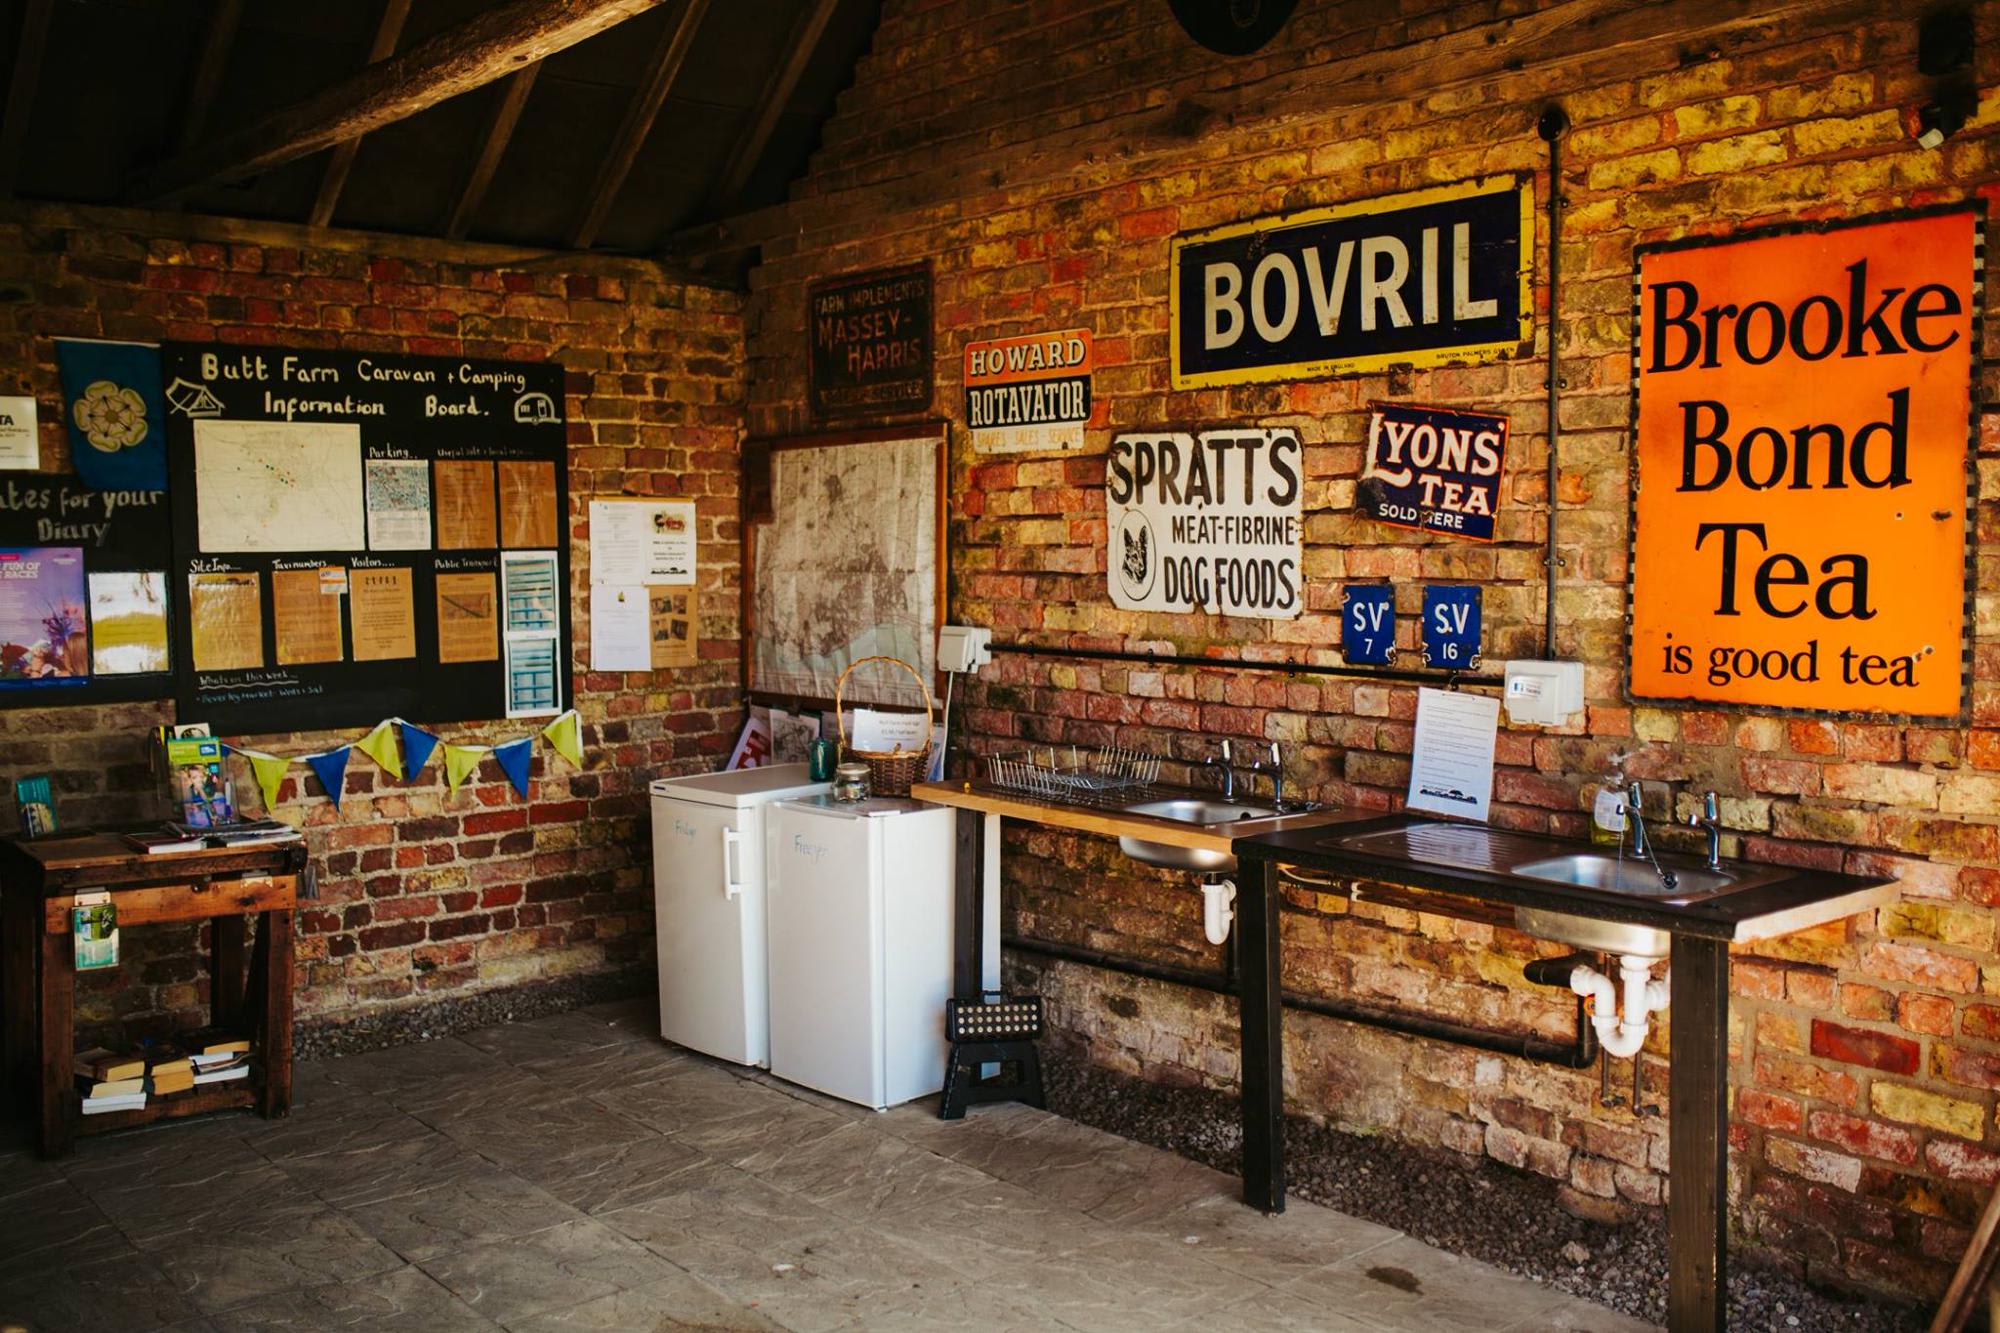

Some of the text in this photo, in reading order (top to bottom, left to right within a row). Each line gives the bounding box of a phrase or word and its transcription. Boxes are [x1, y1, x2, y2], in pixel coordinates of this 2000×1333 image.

[815, 279, 926, 315] FARM IMPLEMENTS
[1204, 222, 1498, 350] BOVRIL
[1646, 257, 1962, 375] Brooke
[847, 337, 922, 373] HARRIS
[970, 338, 1086, 376] HOWARD
[1462, 348, 1492, 358] PALMERS
[201, 353, 269, 381] Butt
[283, 356, 339, 383] Farm
[357, 359, 436, 383] Caravan
[459, 363, 526, 394] Camping
[264, 391, 490, 422] Information Board.
[970, 380, 1086, 426] ROTAVATOR
[1676, 386, 1913, 493] Bond
[60, 487, 96, 517] for
[101, 490, 165, 518] your
[1418, 472, 1491, 517] TEA
[1172, 515, 1296, 546] MEAT-FIBRINE
[1378, 502, 1465, 530] SOLD ERE
[37, 517, 111, 548] Diary
[3, 570, 39, 580] RACES
[26, 561, 41, 571] OF
[189, 557, 212, 574] Site
[272, 559, 294, 570] Taxi
[434, 556, 498, 570] Public Transport
[1695, 522, 1878, 621] Tea
[1163, 555, 1295, 610] DOG FOODS
[1353, 601, 1388, 633] SV
[1364, 638, 1373, 656] 7
[1442, 642, 1459, 660] 16
[1662, 632, 1920, 688] is good tea
[245, 672, 263, 683] this
